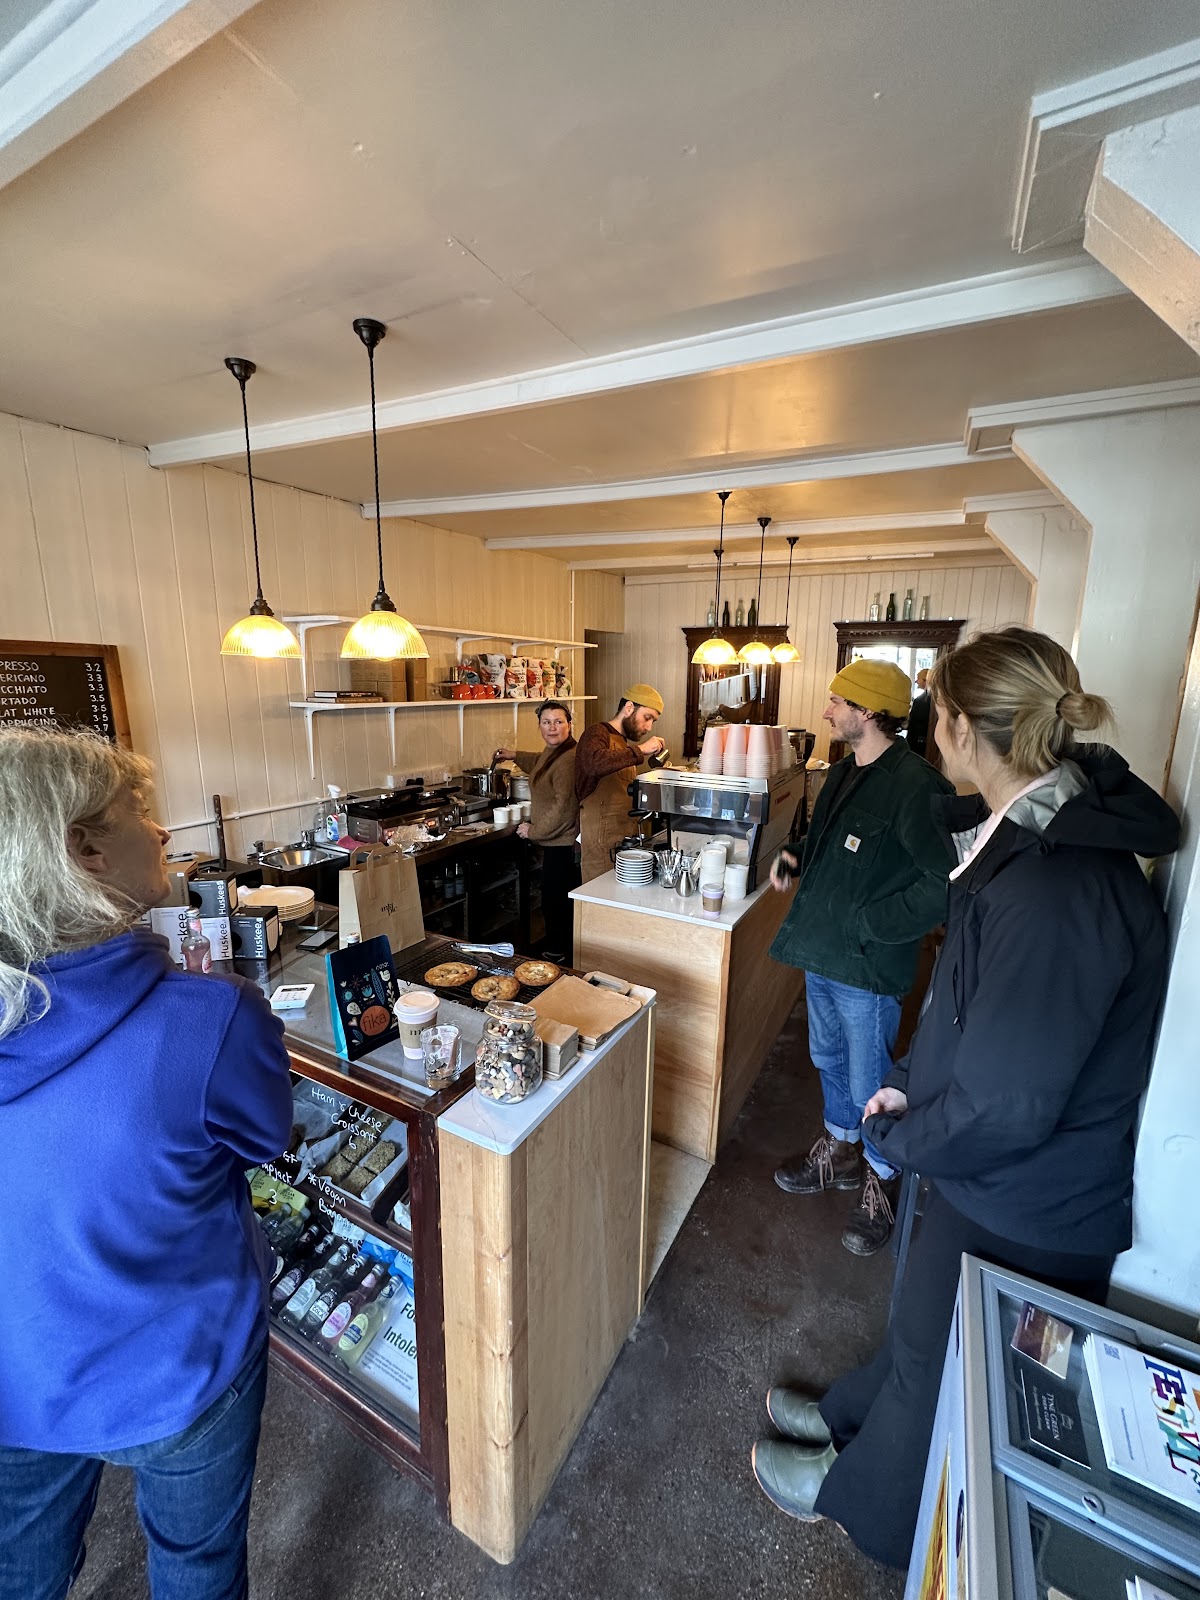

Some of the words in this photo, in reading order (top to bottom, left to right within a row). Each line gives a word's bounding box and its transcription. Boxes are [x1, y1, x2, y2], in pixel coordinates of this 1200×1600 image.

[85, 663, 101, 671] 3.2
[87, 673, 102, 682] 3.3
[0, 685, 48, 694] CCHIATO
[88, 683, 104, 691] 3.3
[1, 697, 37, 705] RTADO
[90, 694, 105, 702] 3.5
[23, 707, 56, 716] WHITE
[91, 704, 107, 712] 3.5
[93, 713, 109, 722] 3.5
[362, 1013, 387, 1032] fika
[311, 1087, 335, 1107] Ham
[348, 1105, 382, 1134] Cheese
[348, 1134, 357, 1150] 6
[269, 1188, 278, 1205] 3
[400, 1302, 416, 1323] Fo
